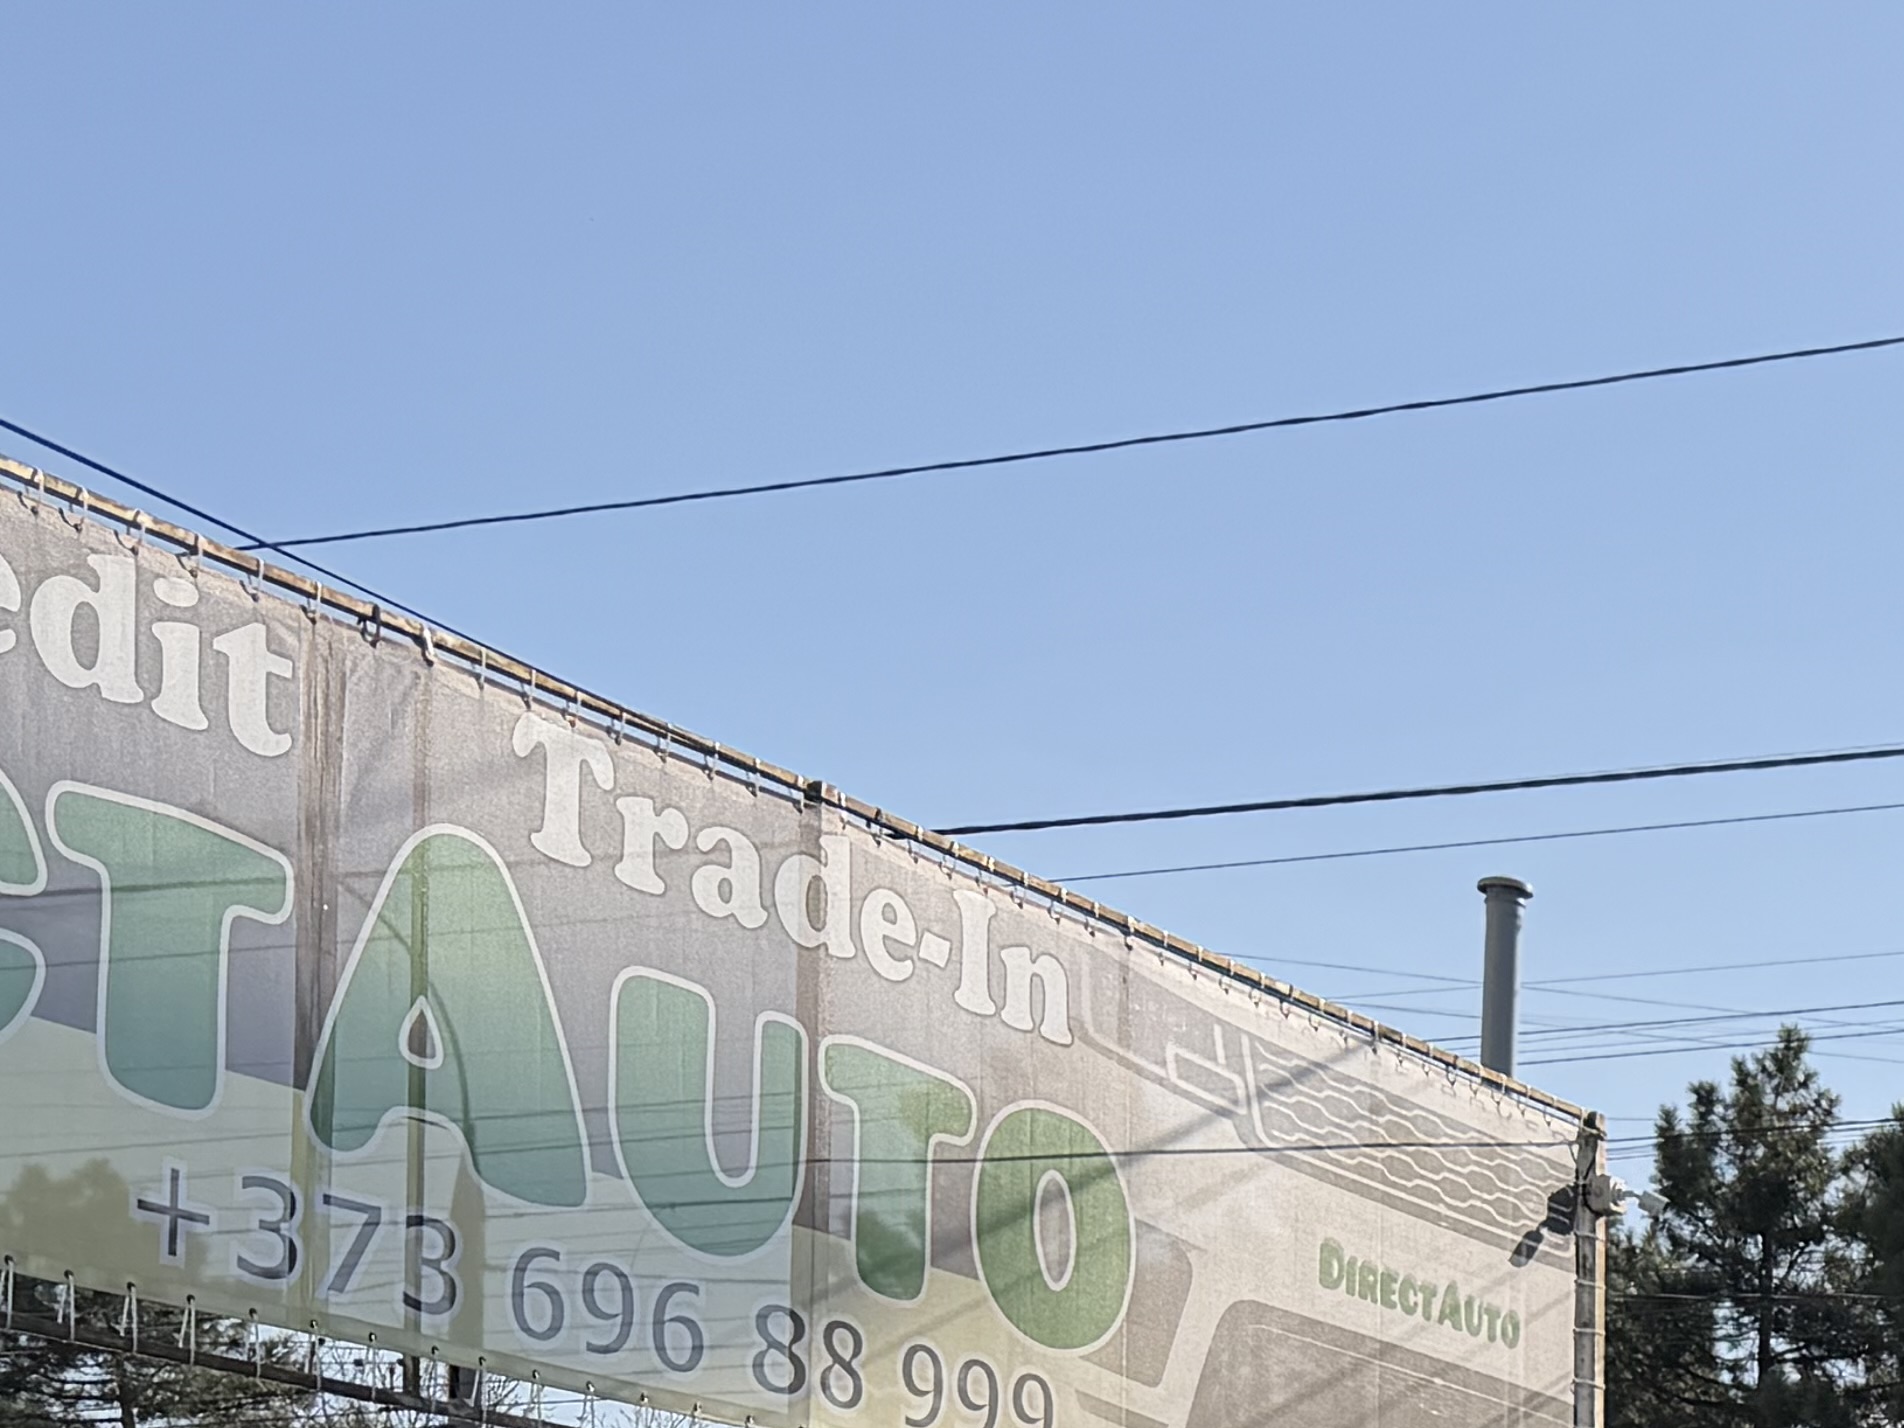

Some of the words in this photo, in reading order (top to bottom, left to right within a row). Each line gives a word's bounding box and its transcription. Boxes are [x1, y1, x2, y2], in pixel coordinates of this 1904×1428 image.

[0, 553, 294, 758] dit
[512, 712, 1074, 1047] Trade-In
[135, 1165, 460, 1315] +373
[510, 1246, 706, 1373] 696
[751, 1304, 864, 1411] 88
